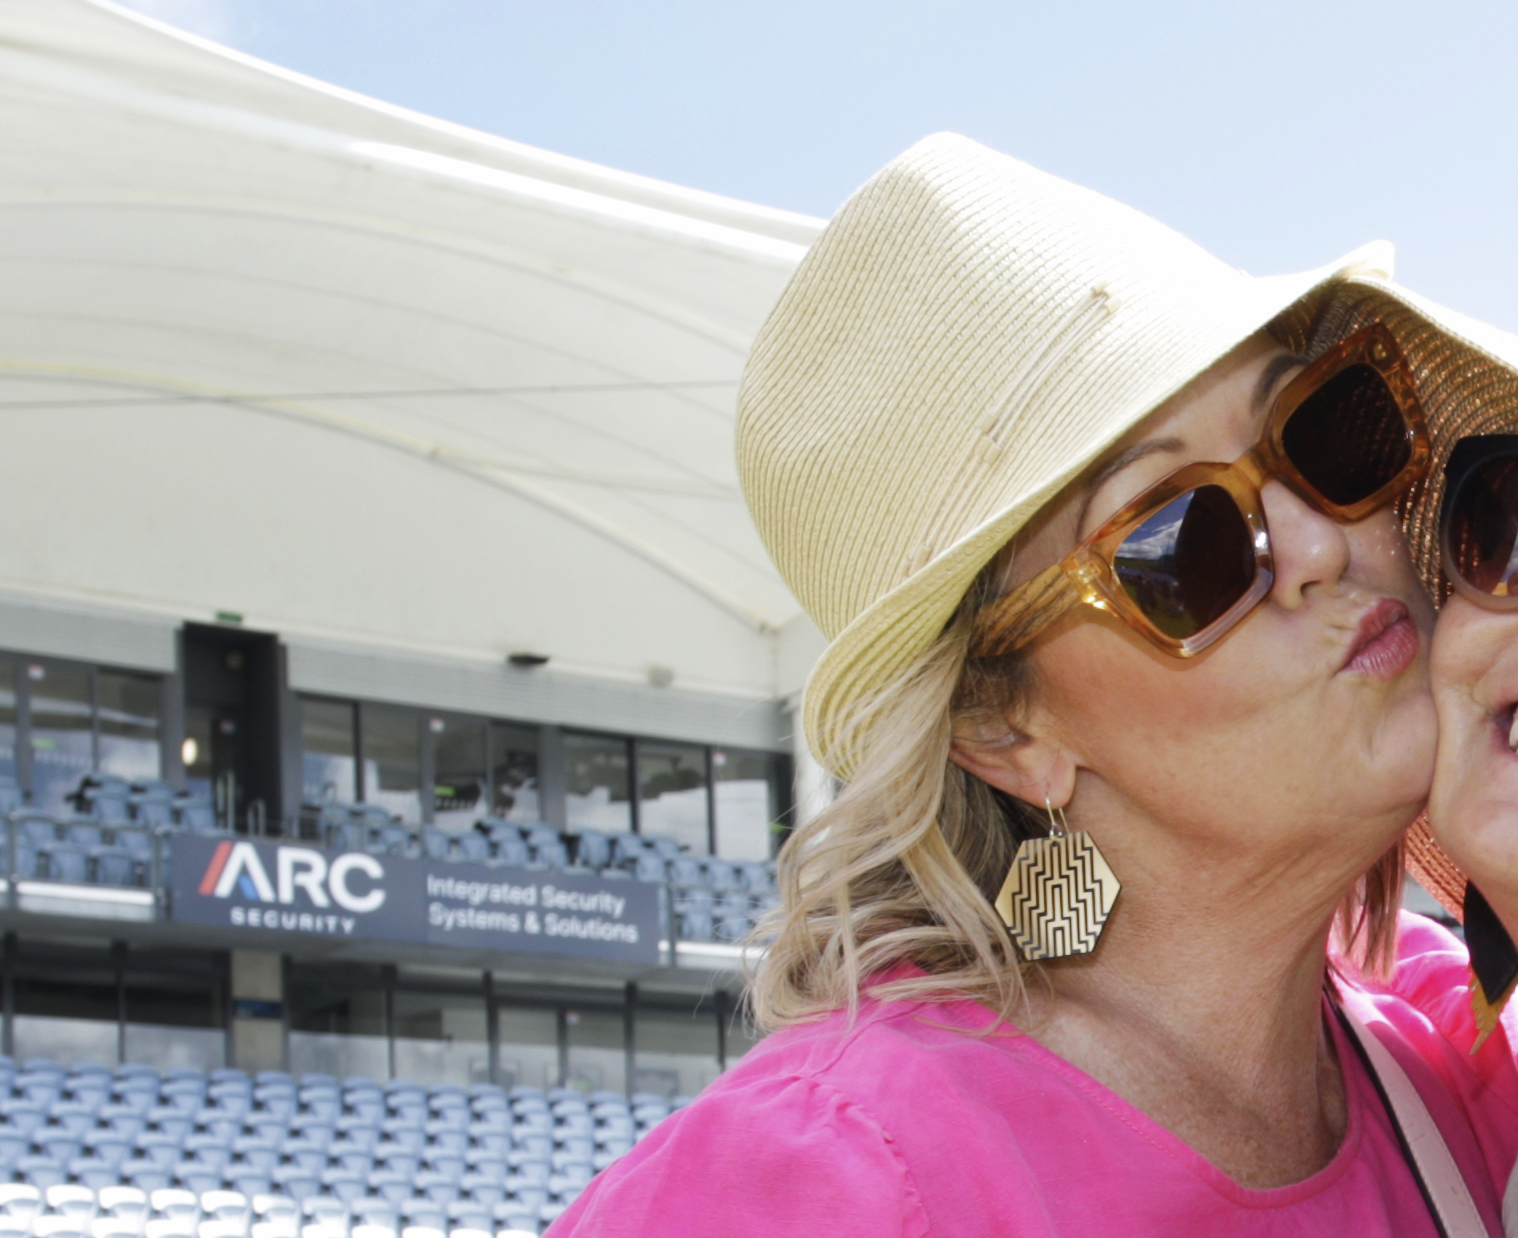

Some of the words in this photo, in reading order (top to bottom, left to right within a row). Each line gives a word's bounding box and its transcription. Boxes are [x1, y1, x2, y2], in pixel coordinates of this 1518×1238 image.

[199, 840, 386, 913] ARC
[427, 874, 537, 906] Integrated
[541, 884, 625, 918] Security
[230, 906, 355, 934] SECURITY
[428, 901, 520, 932] Systems
[523, 910, 540, 934] &
[544, 912, 639, 943] Solutions
